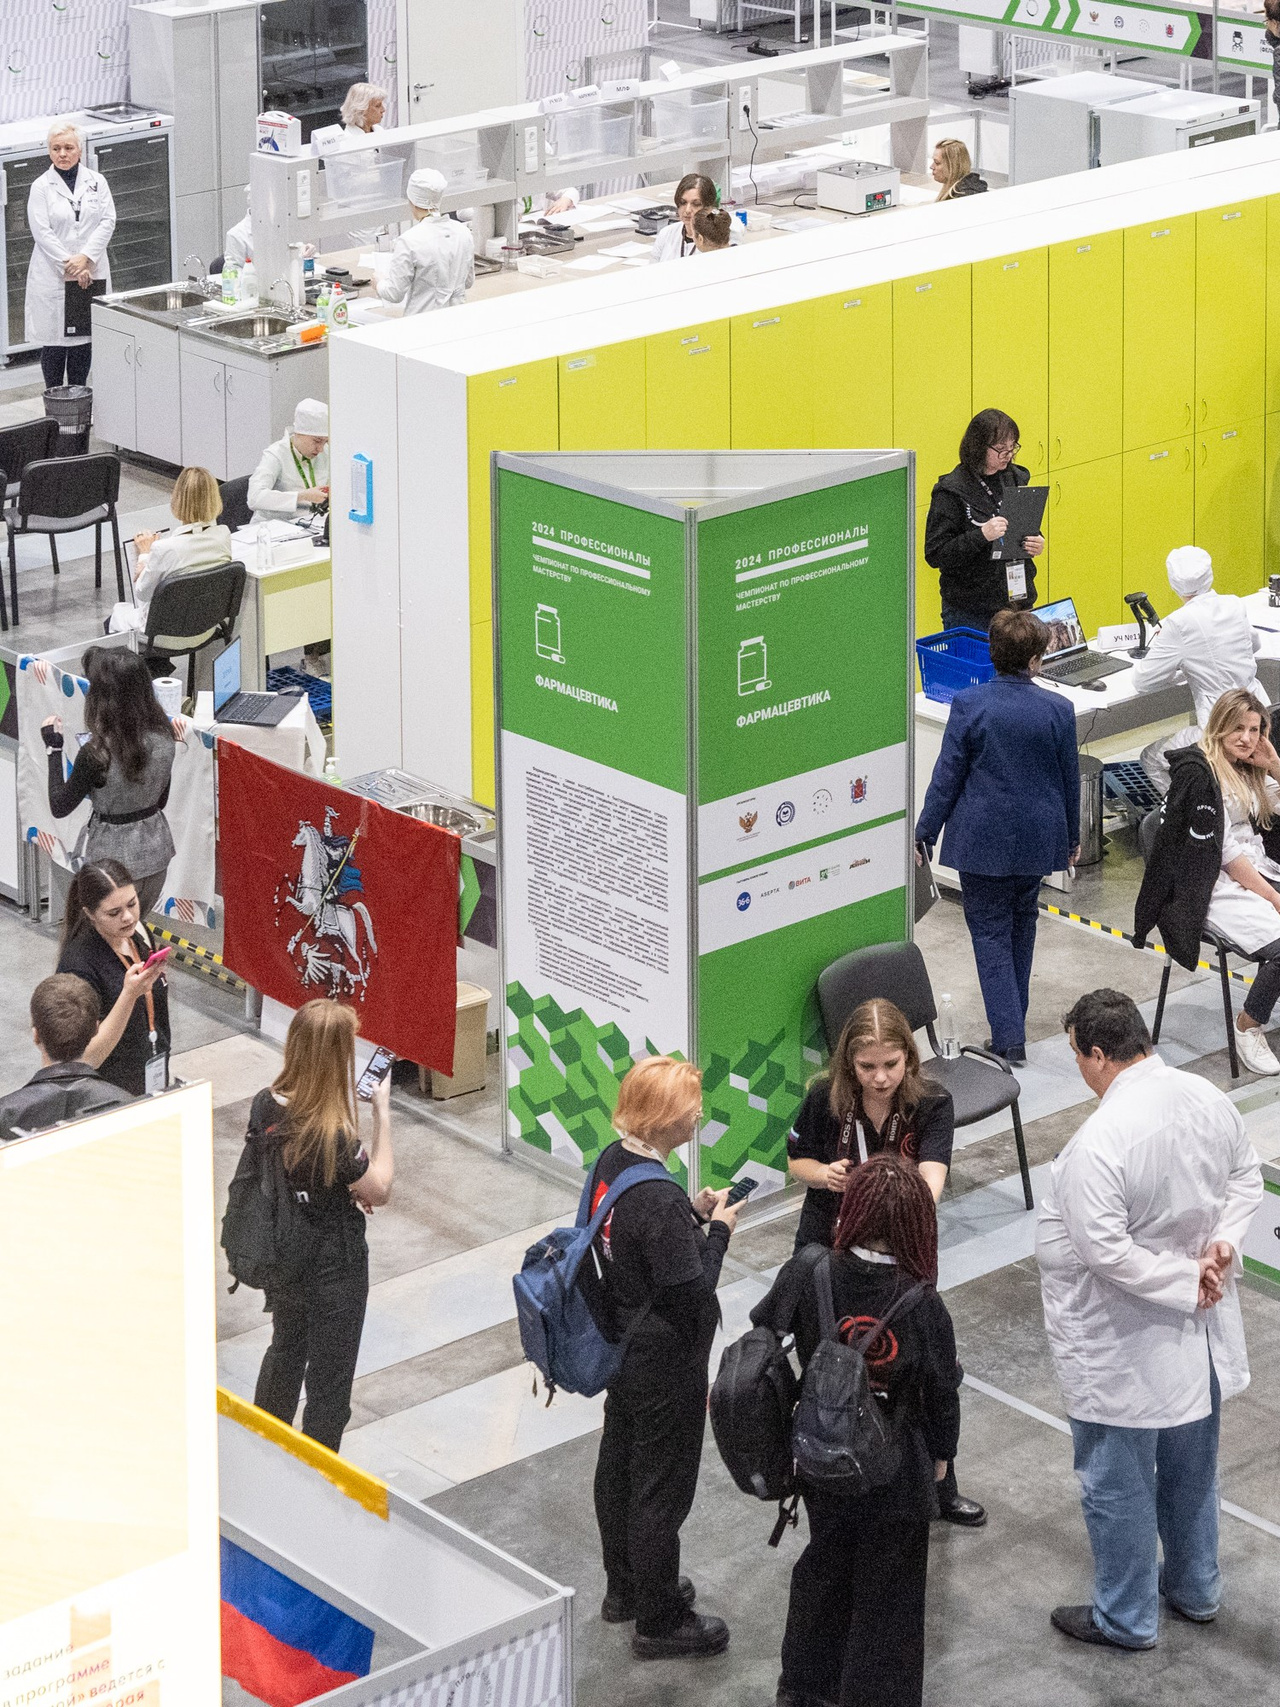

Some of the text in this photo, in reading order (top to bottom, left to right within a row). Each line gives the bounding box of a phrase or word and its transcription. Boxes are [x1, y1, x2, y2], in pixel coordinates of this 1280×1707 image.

[532, 521, 651, 567] 2024 ПРОФЕССИОНАЛЫ
[735, 524, 869, 570] 2024 ПРОФЕССИОНАЛЫ
[532, 564, 572, 582] МАСТЕРСТВУ
[532, 554, 651, 597] ЧЕМПИОНАТ ПО ПРОФЕССИОНАЛЬНОМУ
[736, 557, 869, 600] ЧЕМПИОНАТ ПО ПРОФЕССИОНАЛЬНОМУ
[735, 592, 781, 612] МАСТЕРСТВУ
[535, 674, 618, 713] ФАРМАЦЕВТИКА
[736, 690, 831, 728] ФАРМАЦЕВТИКА
[760, 887, 780, 898] ASEPTA
[795, 877, 811, 887] ВИТА
[842, 1123, 851, 1144] EOS
[889, 1113, 900, 1141] Canon
[15, 1659, 110, 1706] программе
[90, 1664, 152, 1698] ведется
